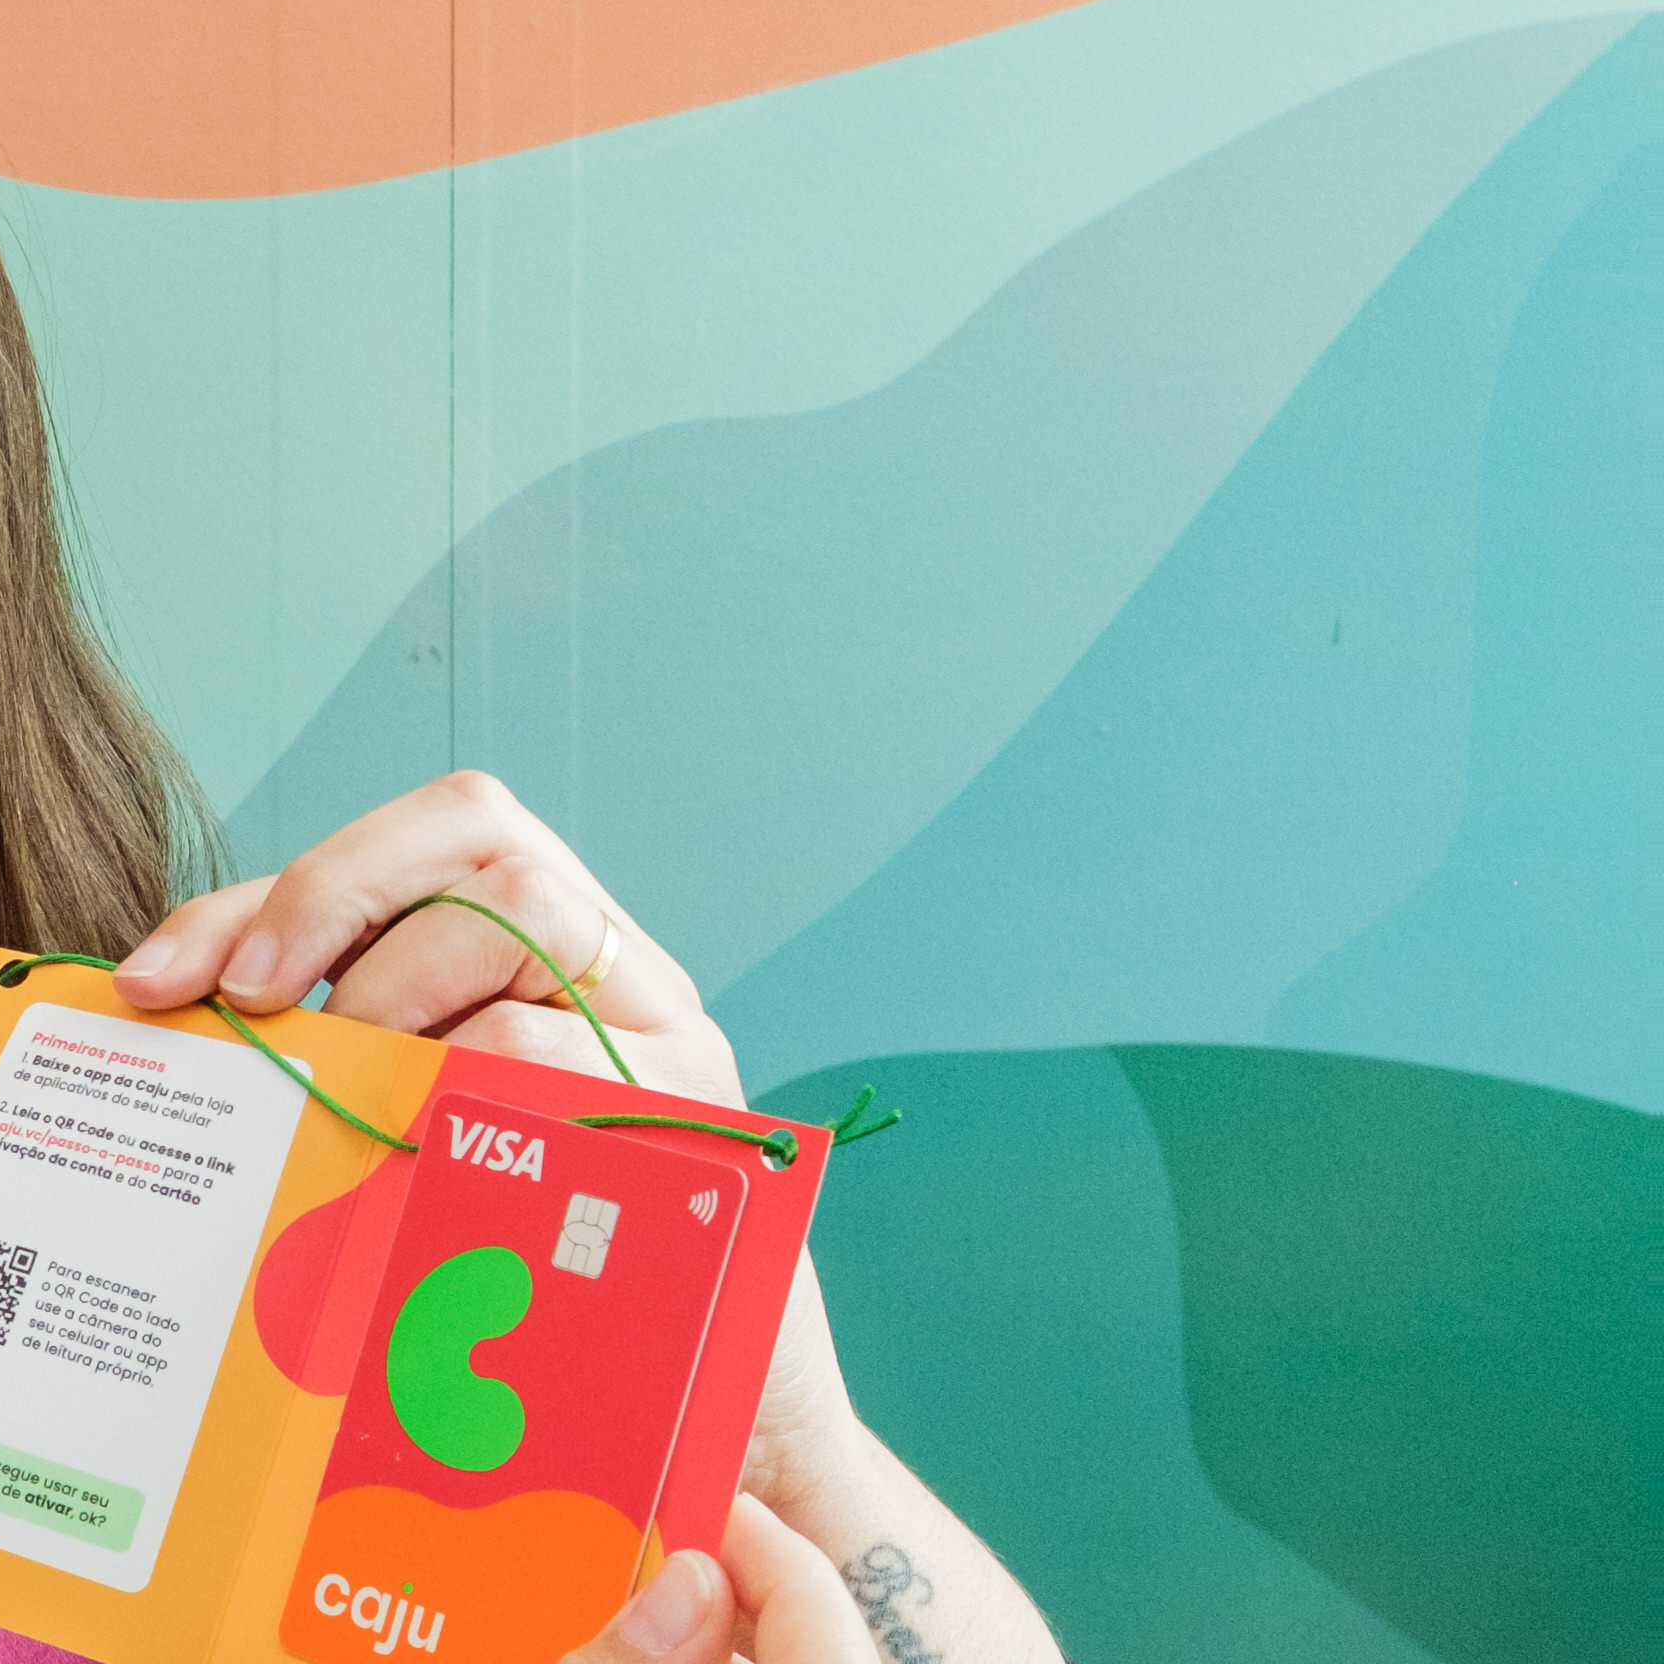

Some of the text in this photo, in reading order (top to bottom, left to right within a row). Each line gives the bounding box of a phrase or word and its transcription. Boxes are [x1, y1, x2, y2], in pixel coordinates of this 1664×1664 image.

[32, 1032, 166, 1072] Primeiros passos
[14, 1069, 211, 1127] de aplicativos do seu celular
[22, 1052, 234, 1115] 1. Baixe o app da Caju pela loja
[12, 1105, 41, 1120] Leia
[43, 1115, 52, 1123] o
[55, 1116, 75, 1129] QR
[77, 1122, 114, 1140] Code
[117, 1134, 135, 1147] ou
[139, 1141, 191, 1162] acesse
[195, 1156, 204, 1165] o
[207, 1157, 235, 1175] link
[445, 1113, 545, 1182] VISA
[49, 1154, 67, 1166] da
[70, 1161, 112, 1180] conta
[115, 1173, 124, 1183] e
[128, 1176, 146, 1189] do
[150, 1184, 200, 1205] cartão
[162, 1167, 199, 1184] para
[203, 1179, 213, 1189] a
[41, 1282, 180, 1332] o QR Code ao lado
[48, 1261, 157, 1303] Para escanear
[29, 1318, 167, 1372] seu celular ou app
[35, 1300, 162, 1347] use a câmera do
[22, 1336, 158, 1387] de leitura próprio.
[1, 1484, 21, 1499] de
[25, 1493, 73, 1519] ativar,
[79, 1512, 106, 1527] ok?
[44, 1478, 78, 1497] usar
[81, 1491, 109, 1508] seu
[314, 1573, 445, 1655] caju
